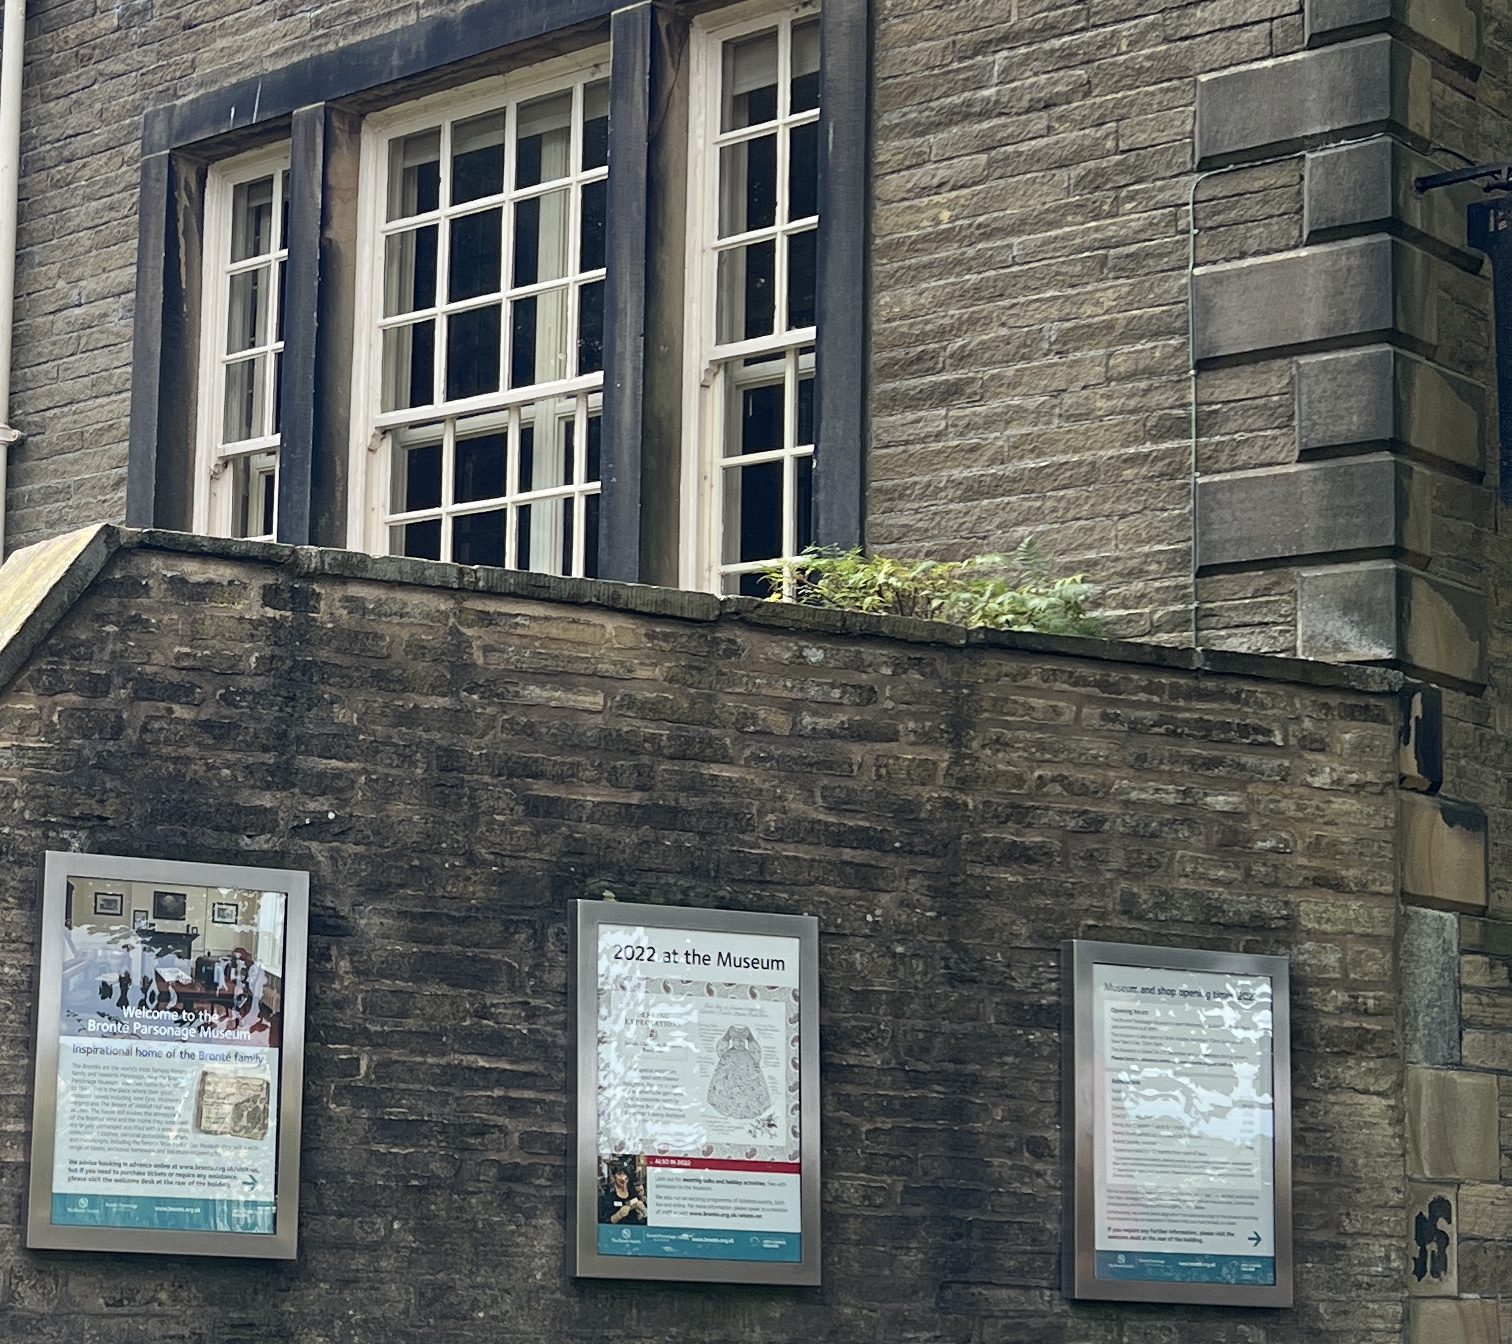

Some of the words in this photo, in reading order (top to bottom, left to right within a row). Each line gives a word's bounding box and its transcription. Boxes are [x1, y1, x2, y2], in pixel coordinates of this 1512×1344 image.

[613, 944, 656, 963] 2022
[662, 949, 679, 964] at
[684, 949, 711, 966] the
[717, 951, 785, 971] Museum
[1104, 982, 1138, 993] Museum
[1141, 986, 1155, 995] and
[1158, 986, 1176, 998] shop
[1179, 989, 1211, 1000] openig
[123, 1005, 178, 1020] Welcome
[182, 1009, 196, 1021] to
[198, 1010, 219, 1023] the
[134, 1024, 196, 1039] Parsonage
[200, 1027, 251, 1040] Museum
[73, 1044, 133, 1056] Inspirational
[136, 1048, 163, 1058] home
[166, 1048, 177, 1059] of
[180, 1050, 195, 1060] the
[235, 1052, 264, 1067] family
